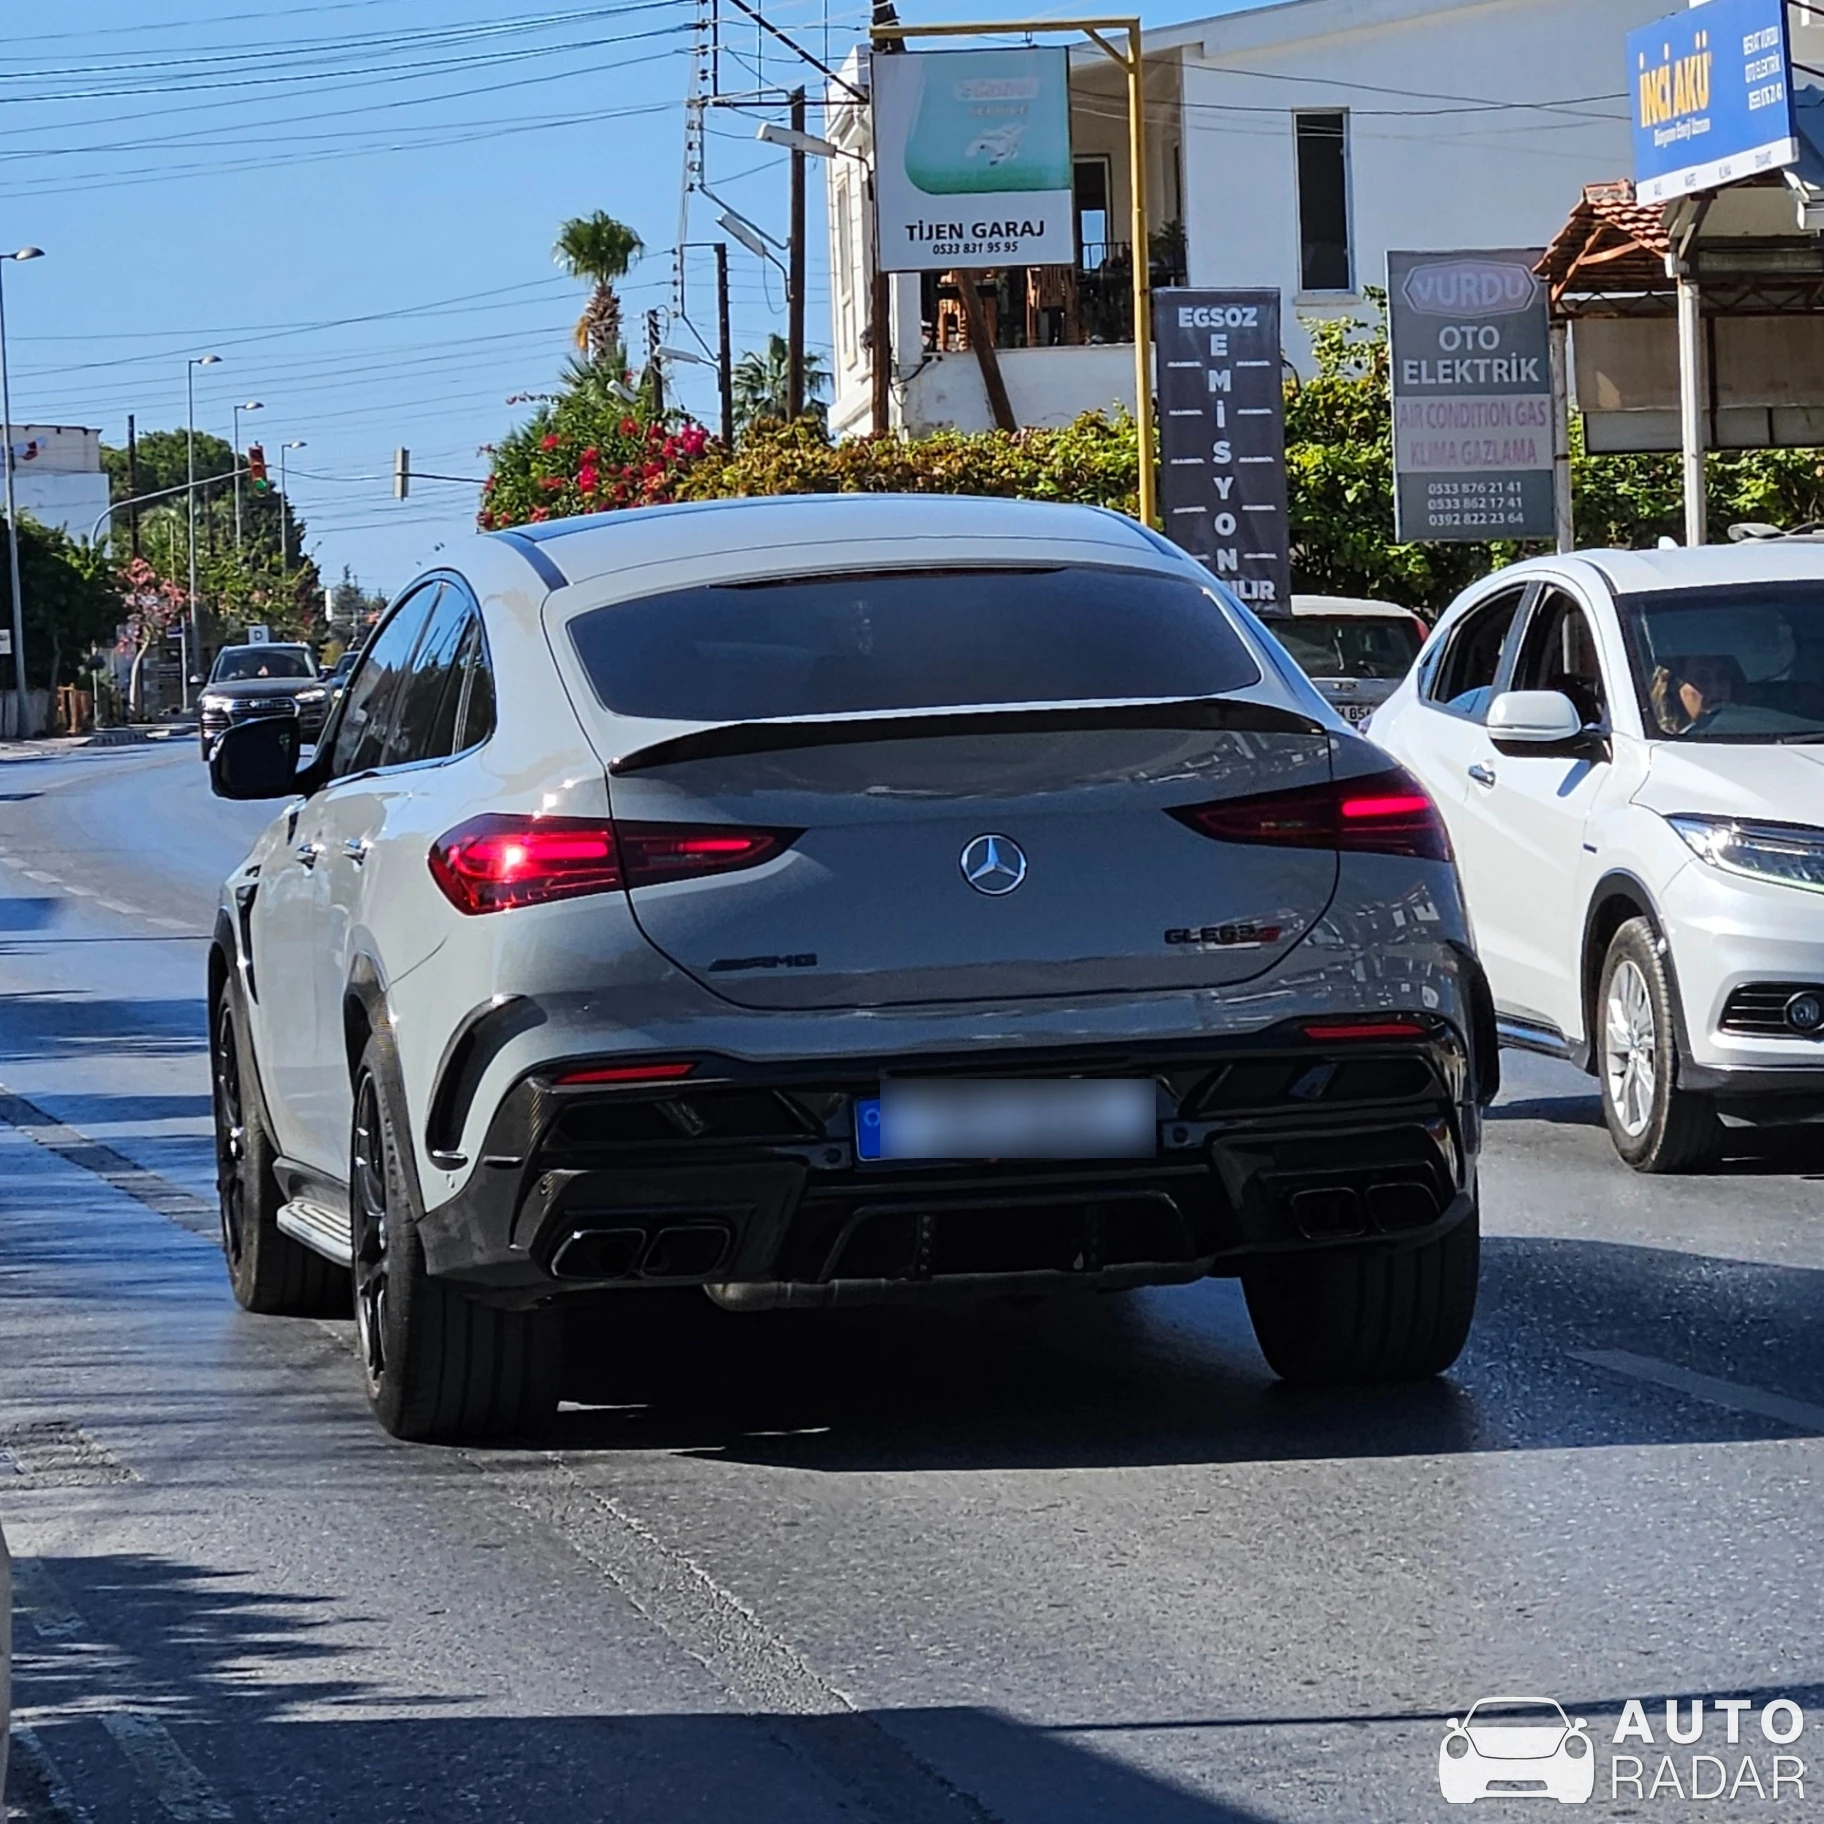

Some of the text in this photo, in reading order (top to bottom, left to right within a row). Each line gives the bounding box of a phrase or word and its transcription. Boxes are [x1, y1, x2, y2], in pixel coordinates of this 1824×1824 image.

[1638, 29, 1711, 128] İNCİ AKÜ
[905, 219, 1044, 240] TİJEN GARAJ
[932, 241, 1018, 255] 0533 831 95 95
[1415, 272, 1524, 307] VURDU
[1178, 306, 1258, 328] EGSOZ
[1438, 325, 1500, 351] OTO
[1403, 352, 1540, 385] ELEKTRİK
[1515, 401, 1546, 427] GAS
[1428, 483, 1459, 495] 0533
[1488, 482, 1503, 493] 21
[1507, 481, 1521, 493] 41
[1507, 497, 1522, 508] 41
